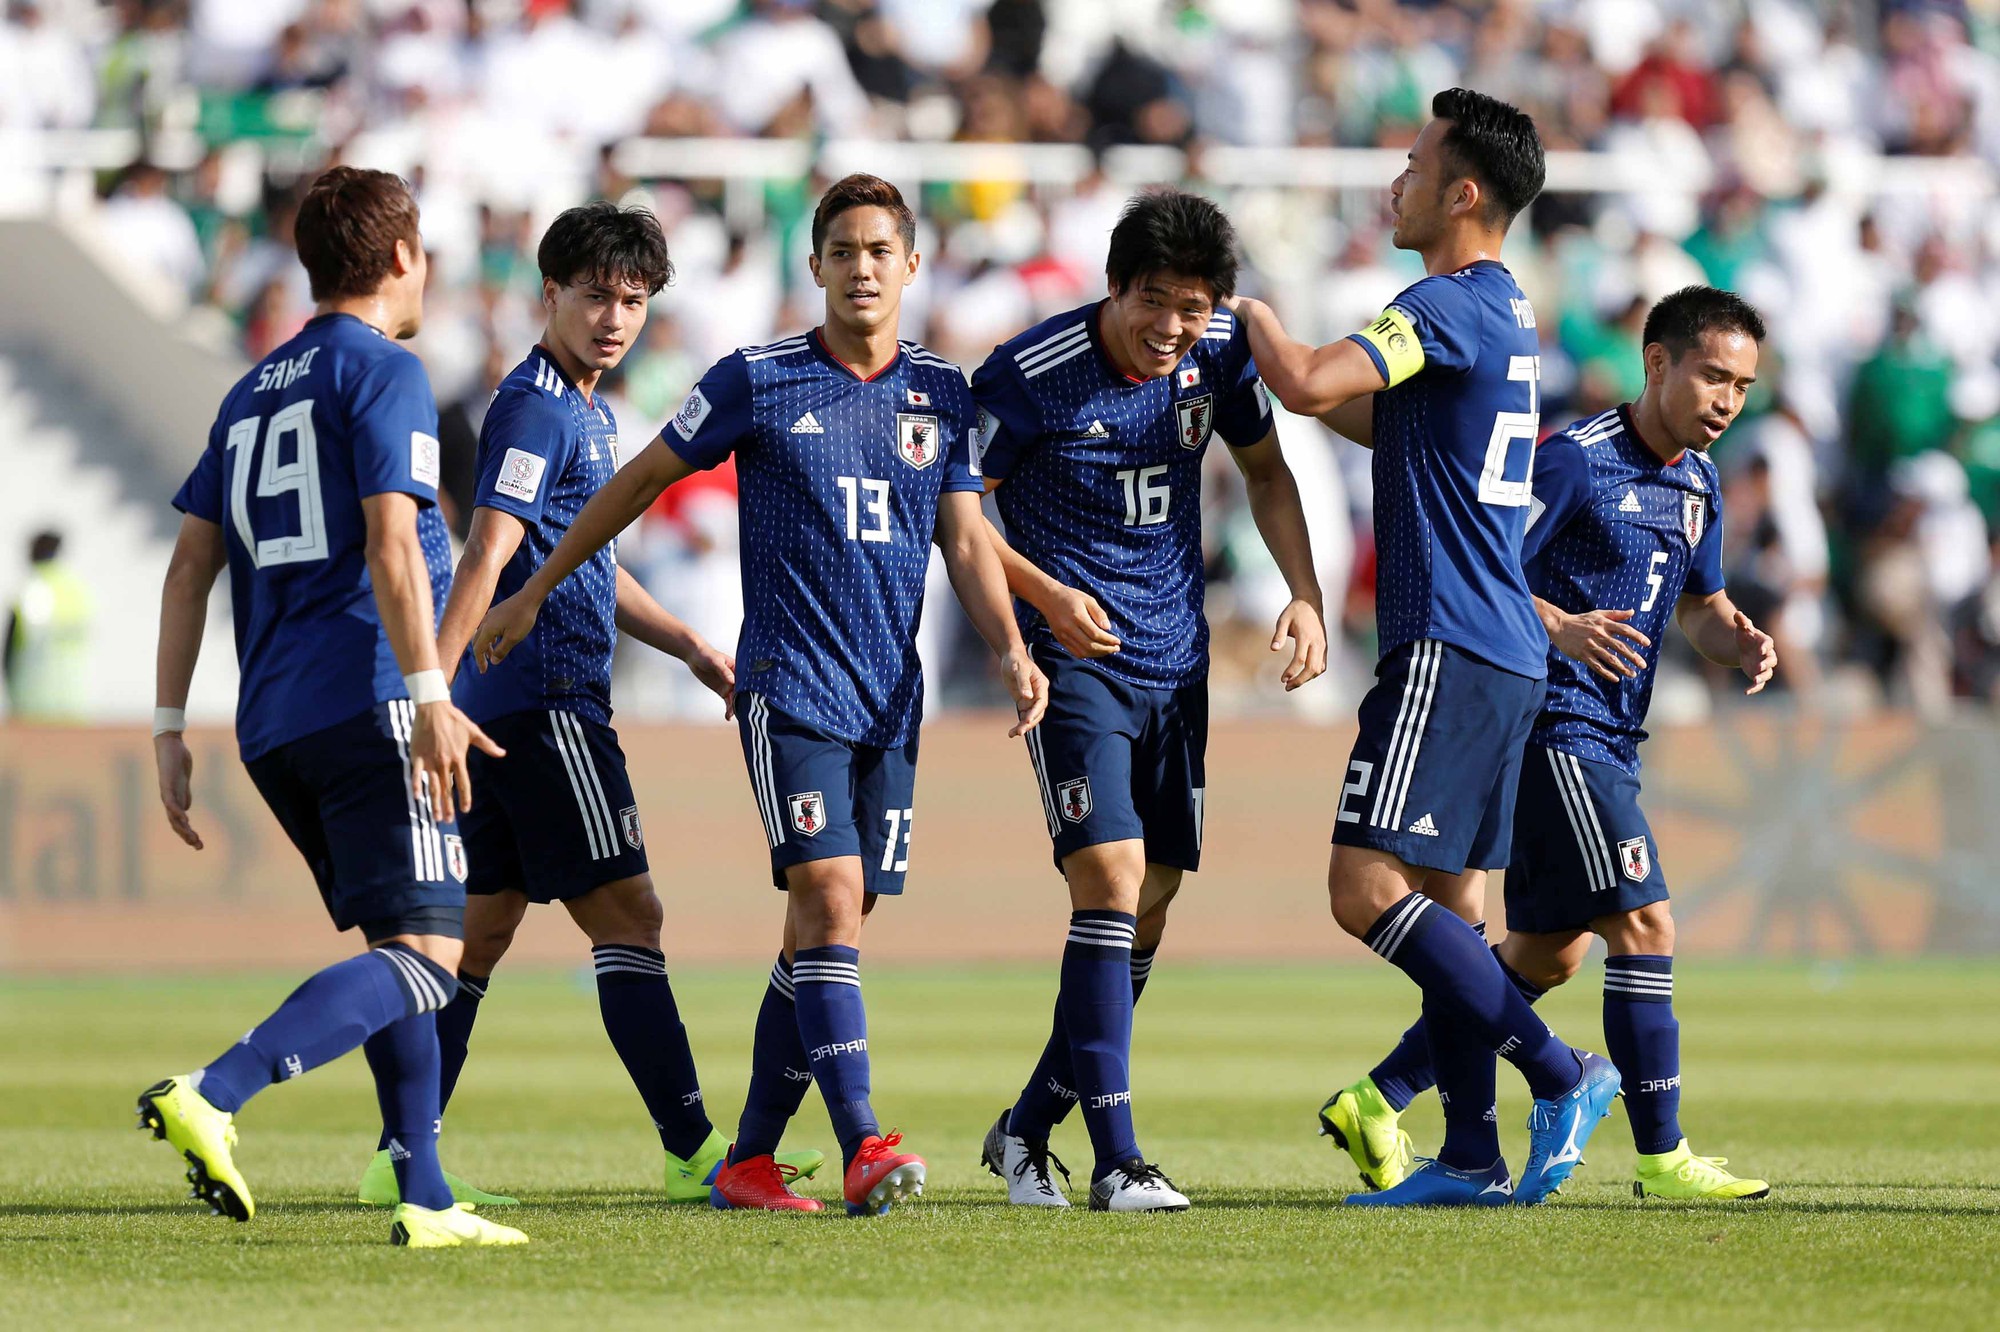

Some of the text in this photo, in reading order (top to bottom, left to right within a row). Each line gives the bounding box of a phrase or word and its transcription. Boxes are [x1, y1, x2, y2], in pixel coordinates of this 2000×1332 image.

[790, 426, 825, 434] adidas
[1478, 355, 1540, 507] 2
[226, 399, 329, 570] 19
[500, 480, 520, 490] ASIAN
[837, 476, 891, 542] 13
[1116, 464, 1170, 526] 16
[1640, 551, 1669, 612] 5
[1192, 788, 1205, 851] 1
[1408, 825, 1439, 837] adidas
[811, 1039, 867, 1062] JAPAN
